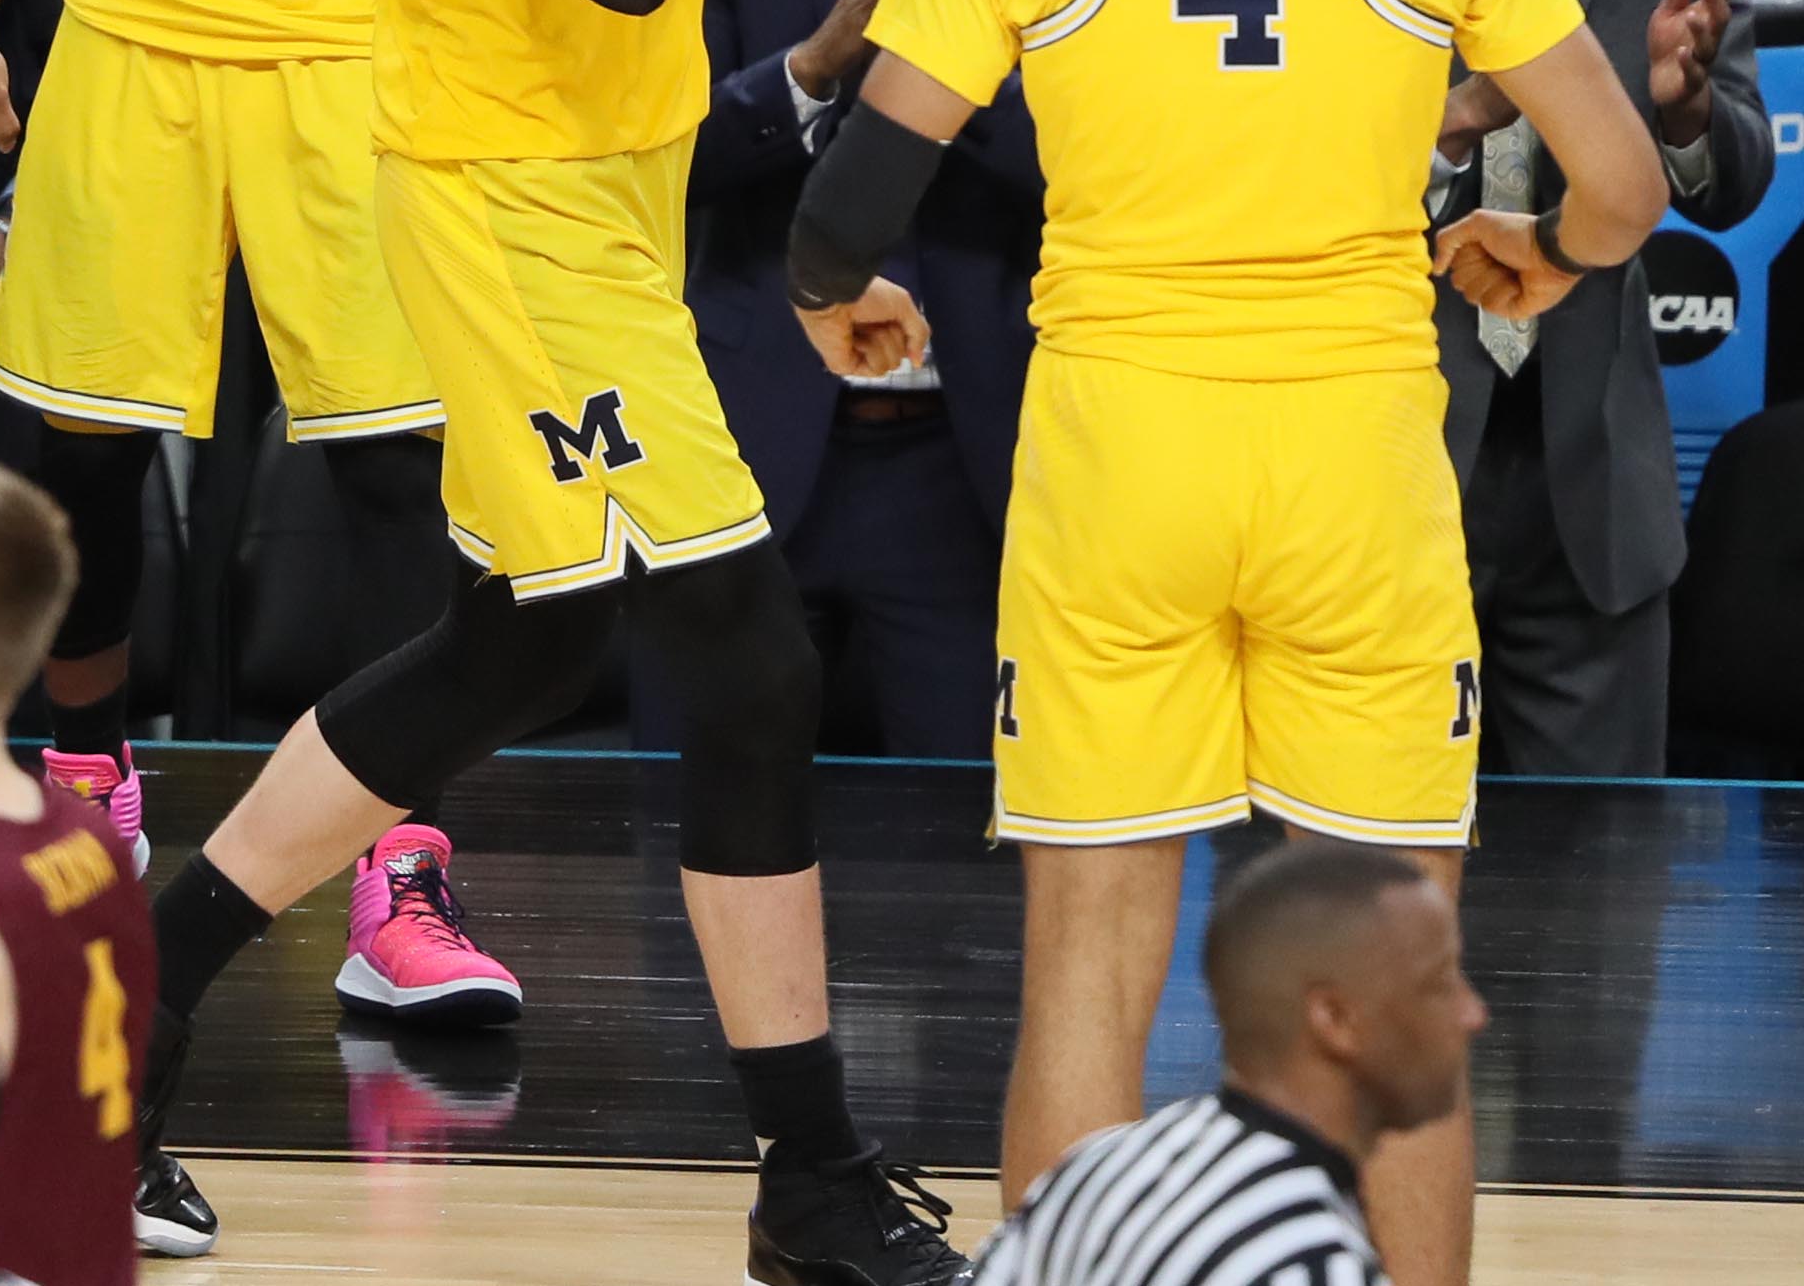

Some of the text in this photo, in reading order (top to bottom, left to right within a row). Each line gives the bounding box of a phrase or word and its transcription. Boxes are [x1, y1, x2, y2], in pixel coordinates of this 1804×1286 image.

[1649, 295, 1735, 331] CAA
[528, 387, 644, 483] M
[80, 938, 133, 1139] 4
